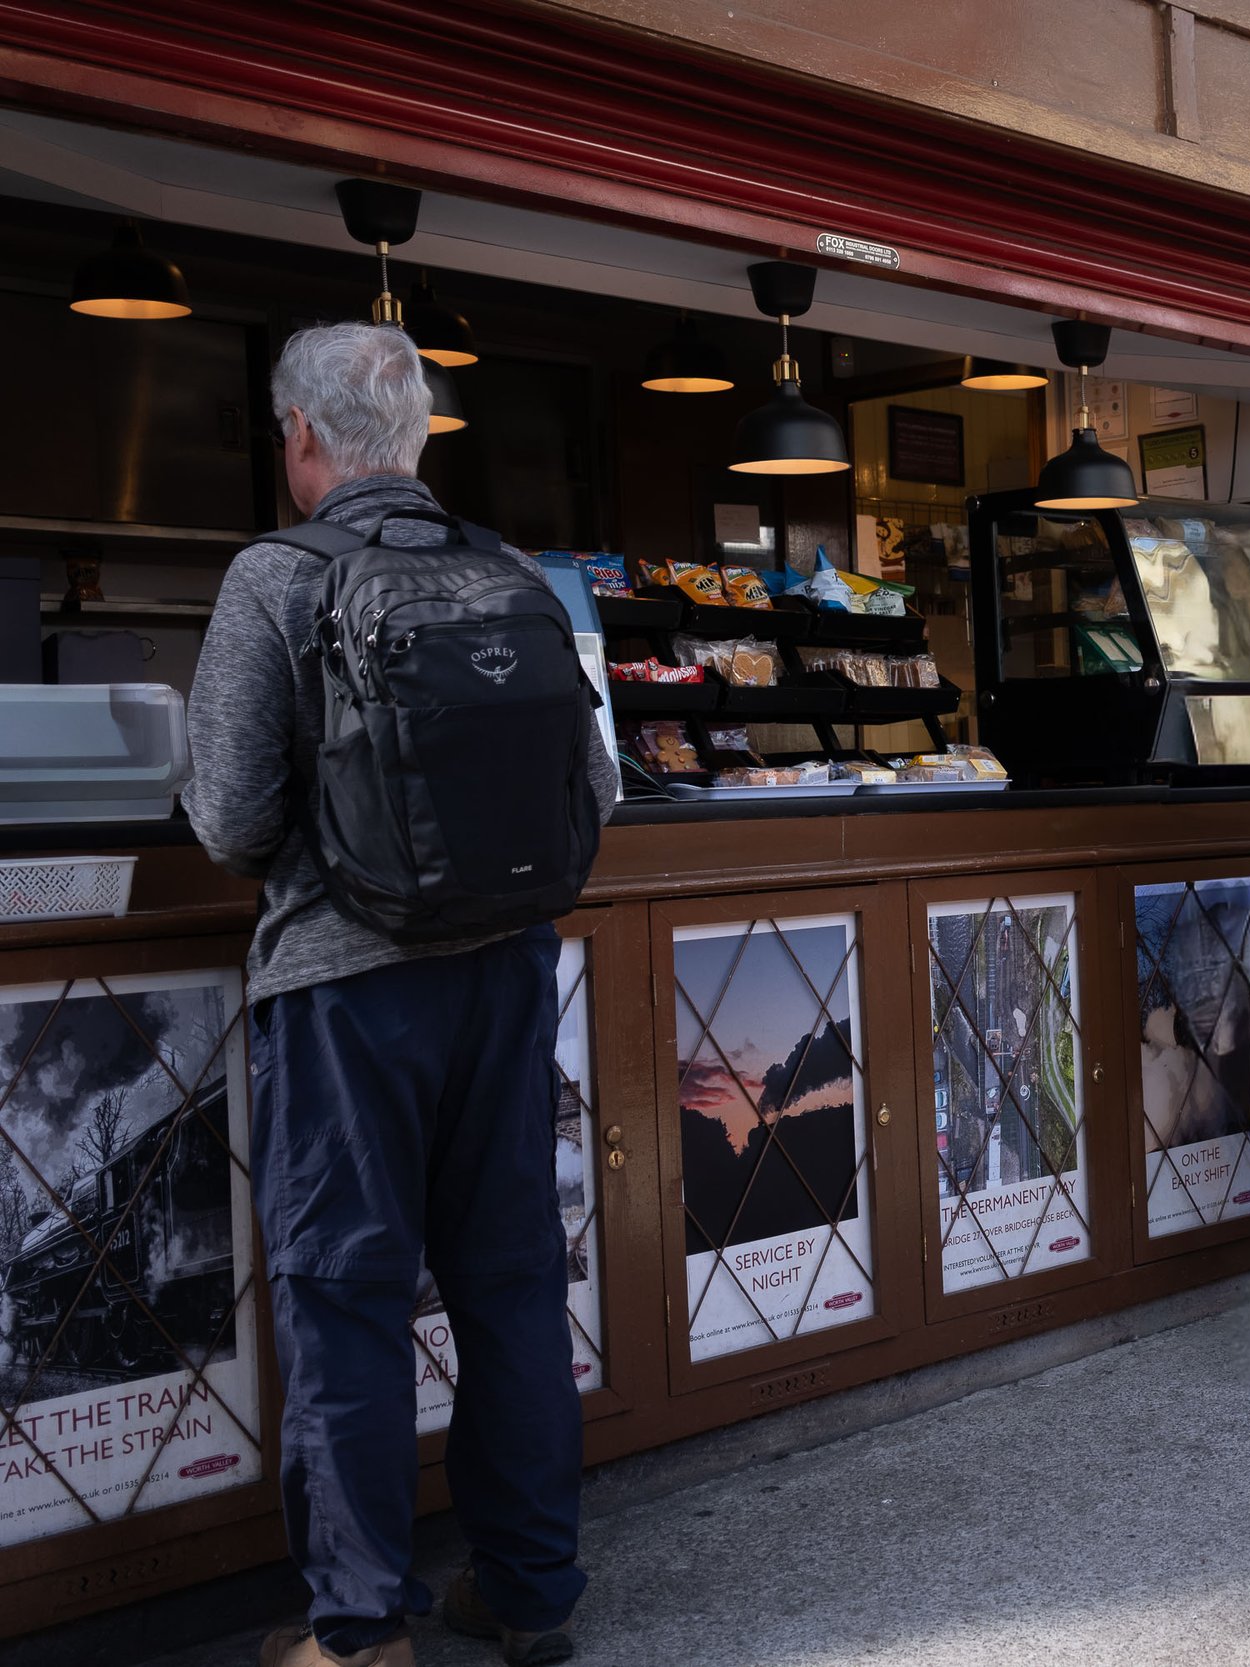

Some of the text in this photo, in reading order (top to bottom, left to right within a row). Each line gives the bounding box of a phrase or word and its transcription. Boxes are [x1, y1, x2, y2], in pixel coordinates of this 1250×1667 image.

[825, 236, 845, 249] FOX
[846, 241, 868, 250] INDUSTRIAL
[869, 245, 883, 254] DOORS
[1191, 448, 1198, 458] 5
[587, 565, 624, 580] RIBO
[471, 647, 516, 662] OSPREY
[512, 864, 532, 874] FLARE
[1182, 1147, 1220, 1166] ON THE
[1172, 1164, 1231, 1190] EARLY SHIFT
[942, 1180, 1076, 1222] THE PERMANENT WAY
[109, 1229, 130, 1251] 5212
[944, 1232, 971, 1248] BRIDGE
[984, 1224, 1004, 1238] OVER
[1005, 1213, 1055, 1233] BRIDGEHOUSE
[1056, 1209, 1074, 1219] BECK
[736, 1238, 815, 1271] SERVICE BY
[976, 1249, 1007, 1263] VOLUNEER
[753, 1266, 801, 1292] NIGHT
[706, 1328, 723, 1338] online
[732, 1314, 775, 1330] www.kwvr.cuk
[784, 1310, 799, 1318] 01535
[801, 1304, 818, 1313] 5214
[416, 1360, 456, 1386] AIL
[50, 1401, 111, 1435] THE
[117, 1384, 209, 1420] TRAIN
[61, 1438, 113, 1467] THE
[123, 1415, 212, 1454] STRAIN
[186, 1458, 233, 1475] WORTH VALLEY
[28, 1491, 100, 1513] www.kwvr.o.uk
[115, 1480, 139, 1491] 01535
[144, 1472, 169, 1484] 45214
